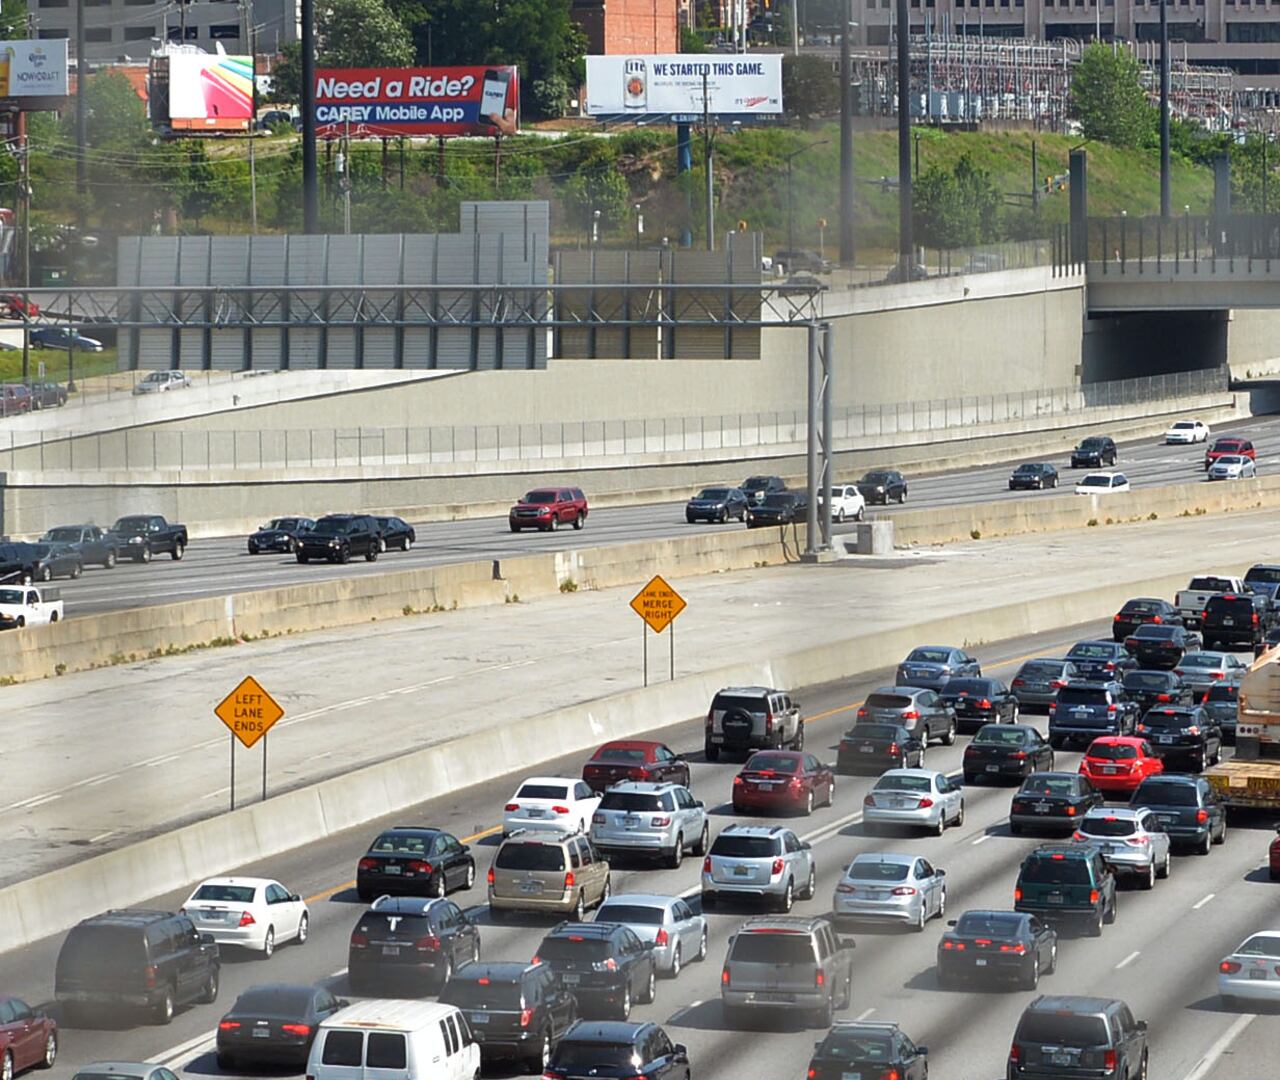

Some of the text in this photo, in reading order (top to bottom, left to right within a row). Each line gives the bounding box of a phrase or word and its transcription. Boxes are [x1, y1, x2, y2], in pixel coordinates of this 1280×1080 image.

[653, 62, 765, 76] WE STARTED THIS GAME.
[316, 75, 475, 98] Need a Ride?
[316, 104, 464, 122] CAREY Mobile App
[643, 600, 673, 608] MERGE
[644, 610, 672, 619] RIGHT
[235, 694, 263, 705] LEFT
[234, 708, 264, 718] LANE
[234, 721, 264, 732] ENDS
